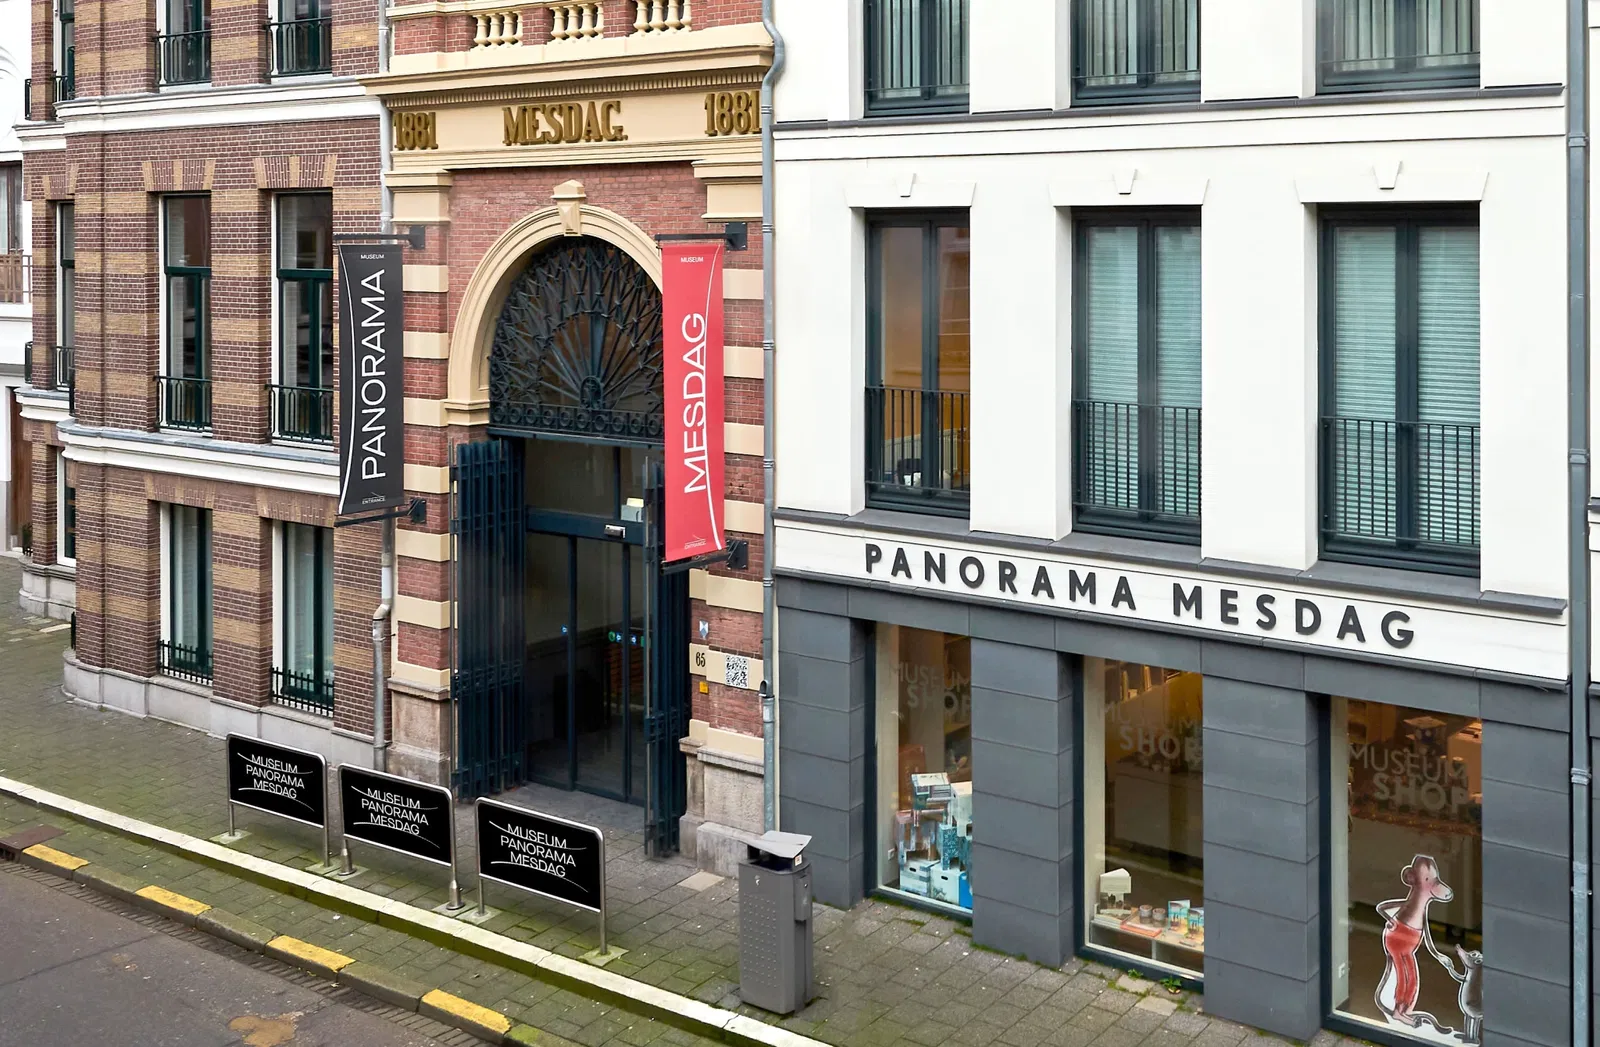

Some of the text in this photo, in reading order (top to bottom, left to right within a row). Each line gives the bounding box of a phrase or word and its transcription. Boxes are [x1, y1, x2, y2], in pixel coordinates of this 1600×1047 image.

[393, 112, 438, 150] 1881
[704, 90, 762, 136] 1881
[361, 269, 386, 480] PANORAMA
[682, 313, 707, 493] MESDAG
[865, 543, 1415, 649] PANORAMA MESDAG
[695, 652, 706, 667] 65
[246, 764, 305, 789] PANORAMA
[251, 754, 298, 774] MUSEUM
[1349, 743, 1469, 788] MUSEUM
[253, 778, 298, 799] MESDAG
[367, 787, 421, 810] MUSEUM
[1373, 772, 1469, 816] SHOP
[361, 798, 429, 826] PANORAMA
[370, 812, 420, 835] MESDAG
[507, 823, 567, 849] MUSEUM
[500, 834, 577, 867] PANORAMA
[510, 851, 566, 878] MESDAG
